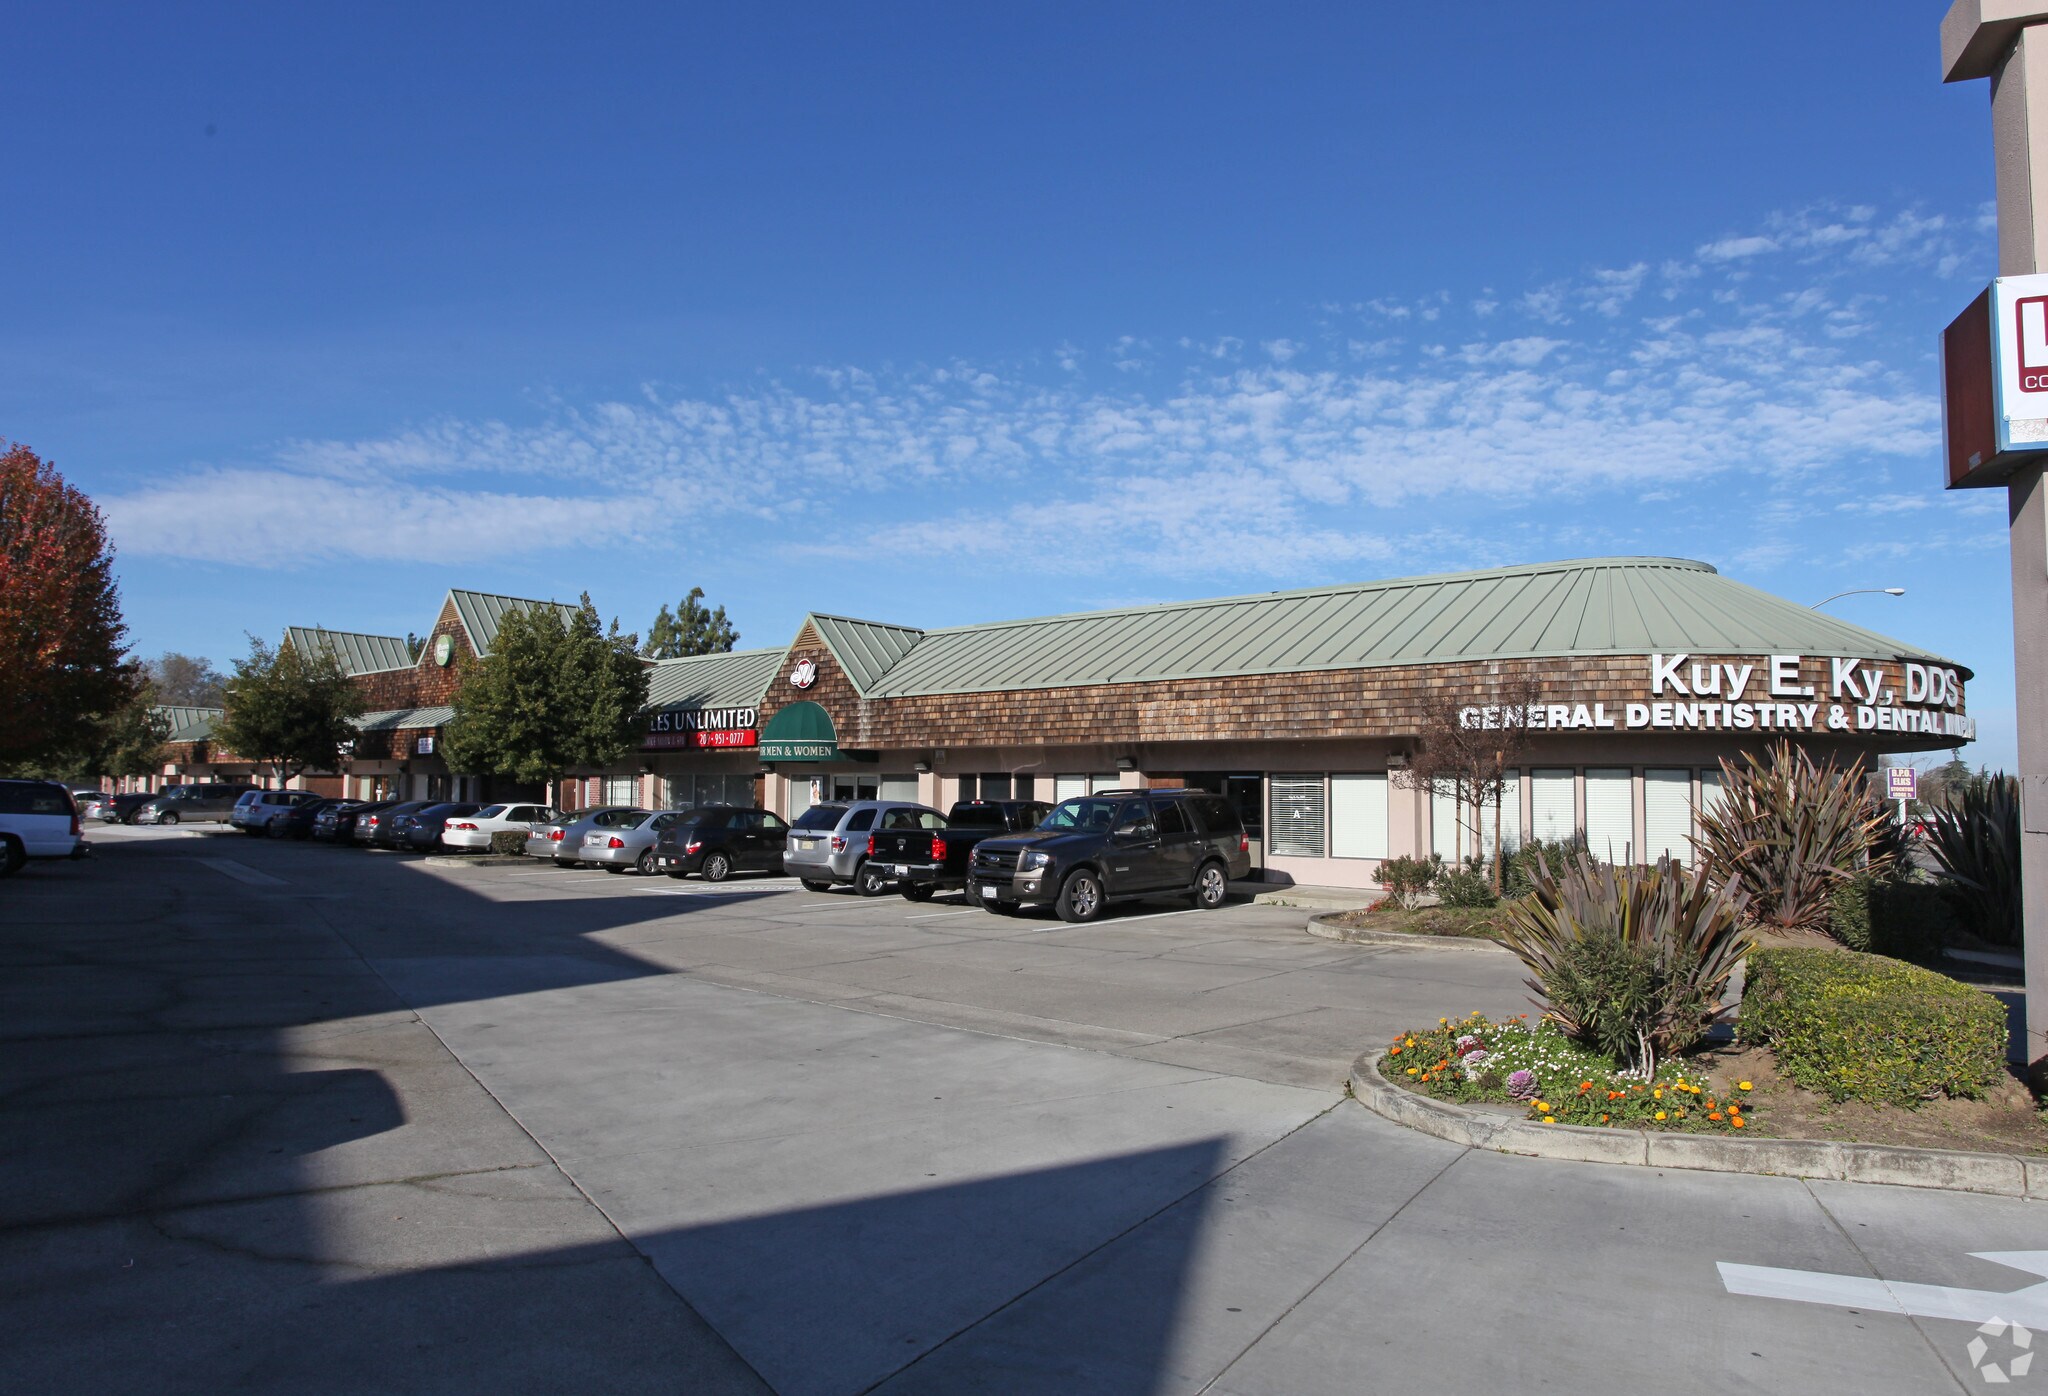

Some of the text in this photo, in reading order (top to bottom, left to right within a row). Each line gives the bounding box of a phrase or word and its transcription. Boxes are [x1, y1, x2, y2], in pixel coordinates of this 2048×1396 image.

[1651, 653, 1959, 708] Kuy E. Ky, DDS
[675, 708, 756, 731] UNLIMITED
[1459, 703, 1614, 730] GENERAL
[1626, 703, 1819, 729] DENTISTRY
[1828, 704, 1850, 730] &
[1857, 705, 1941, 734] DENTAL
[766, 746, 782, 756] MEN
[784, 746, 792, 757] &
[793, 746, 832, 757] WOMEN
[1893, 777, 1911, 786] ELKS
[1293, 810, 1301, 819] A
